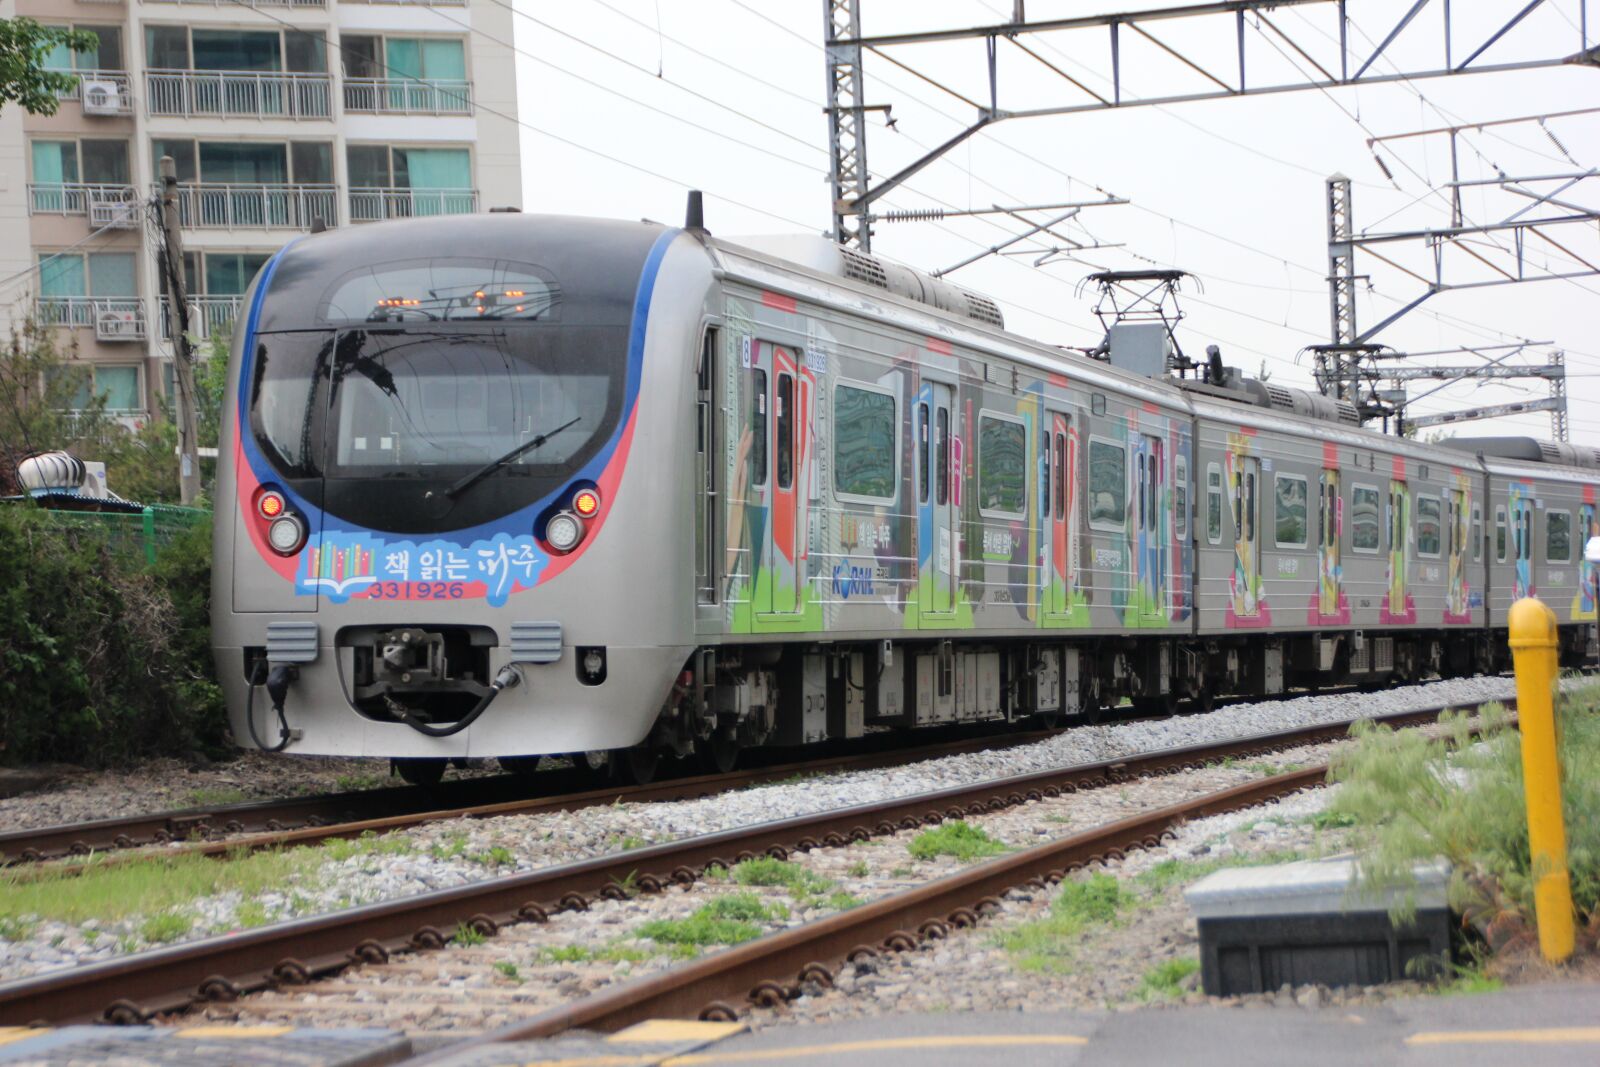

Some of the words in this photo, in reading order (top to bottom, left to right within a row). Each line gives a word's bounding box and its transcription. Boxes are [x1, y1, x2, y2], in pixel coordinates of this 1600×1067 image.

[743, 339, 750, 364] 8
[384, 550, 410, 581] 책
[419, 549, 470, 580] 읽는
[477, 542, 540, 597] 파주
[832, 557, 874, 599] KORAIL
[369, 581, 465, 599] 331926
